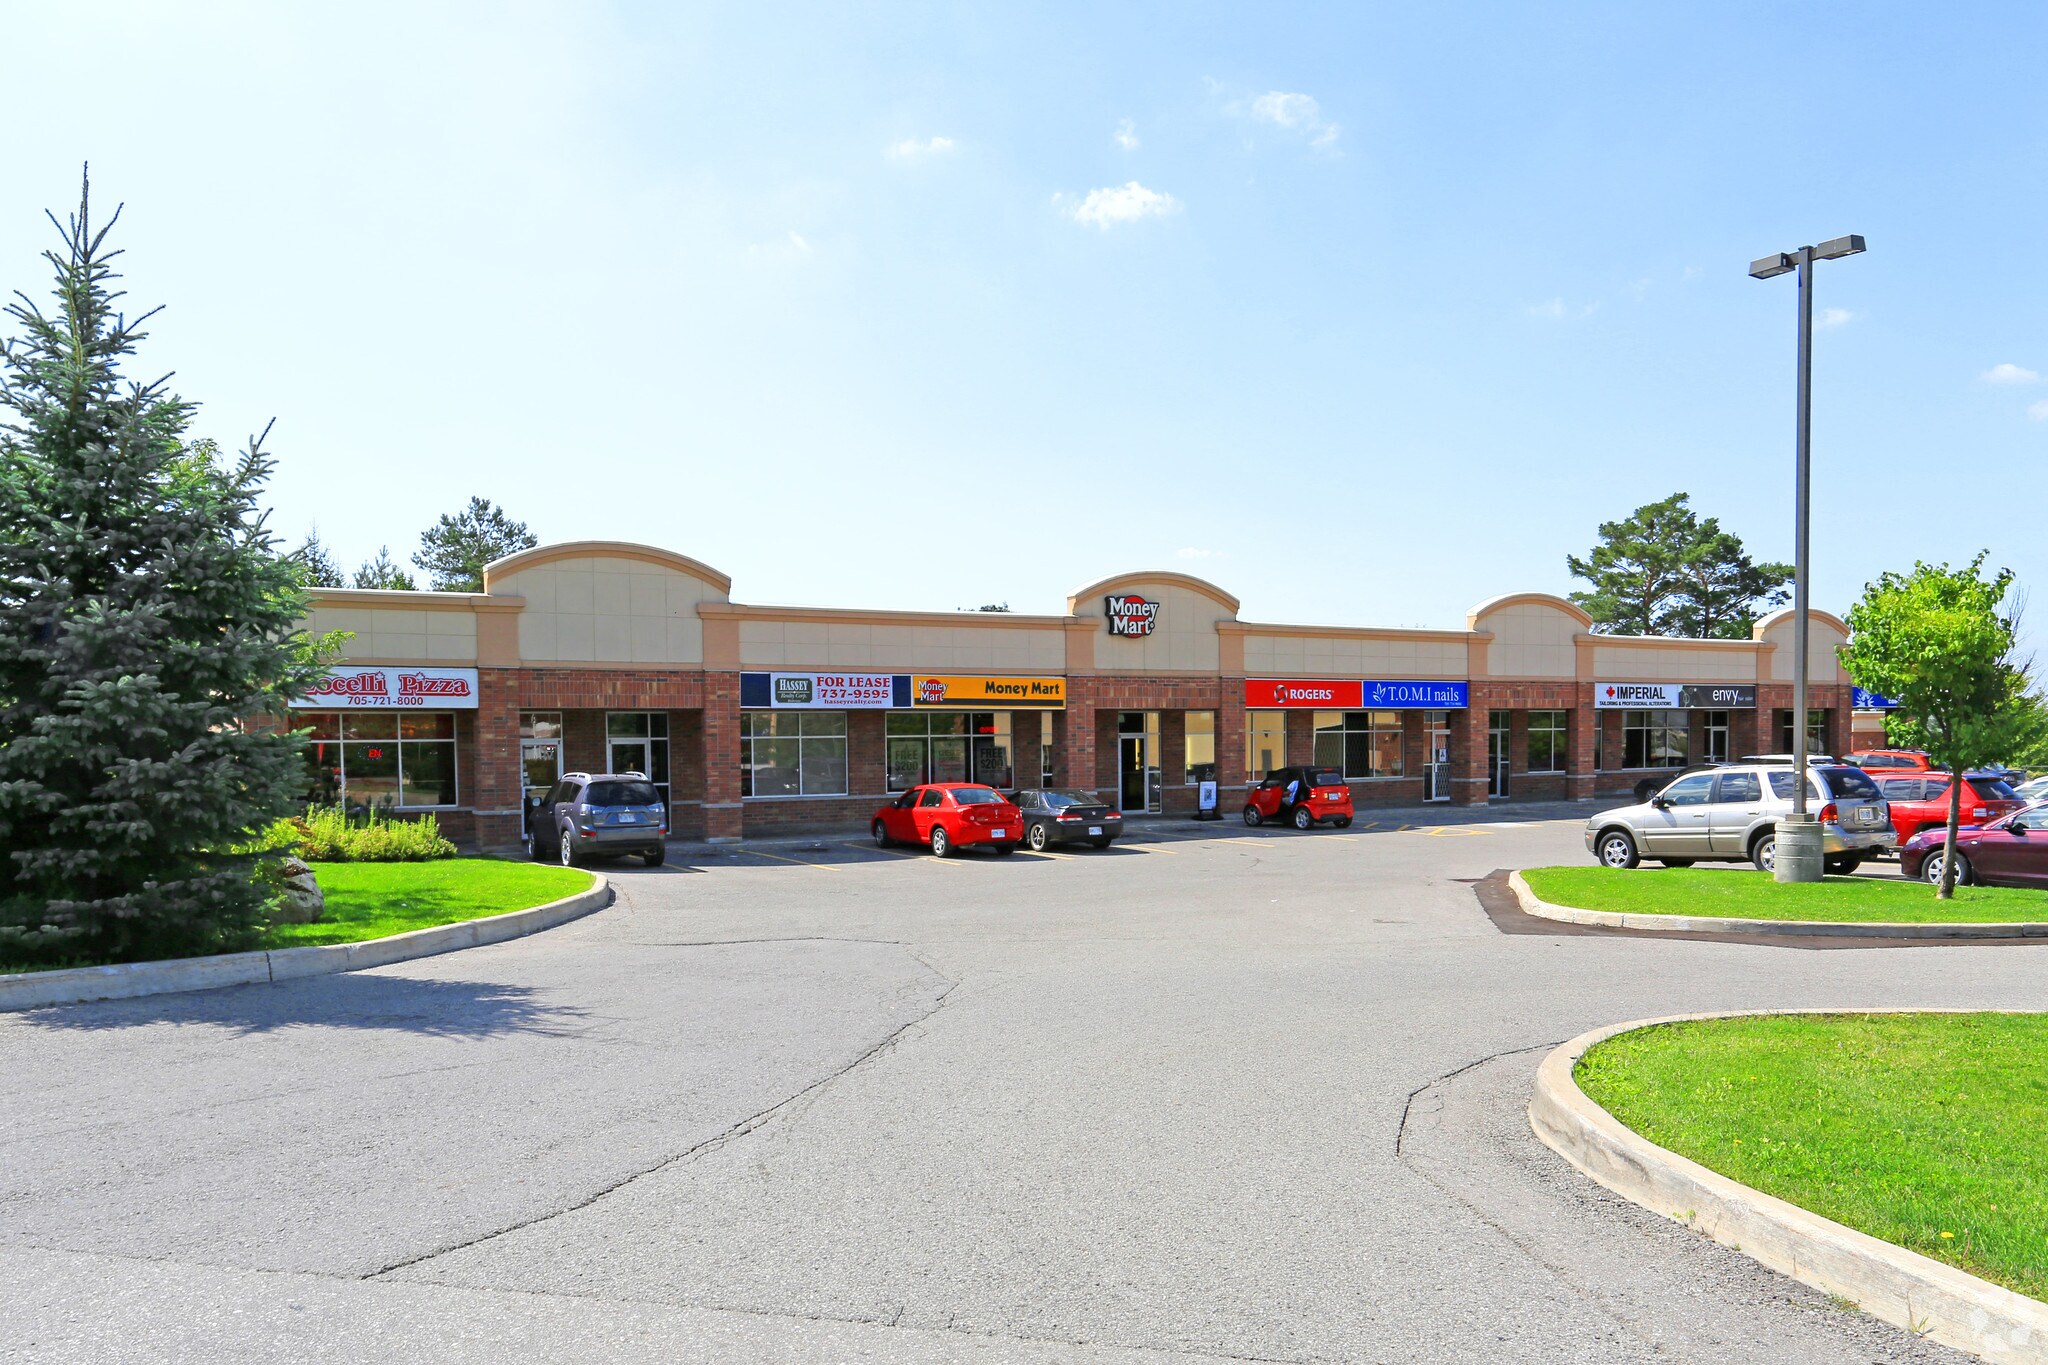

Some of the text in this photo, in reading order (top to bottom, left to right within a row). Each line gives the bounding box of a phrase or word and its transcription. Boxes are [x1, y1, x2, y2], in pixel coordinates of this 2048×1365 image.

[1108, 597, 1159, 622] Money
[1112, 615, 1152, 634] Mart
[303, 671, 471, 696] ocelli Pizza
[780, 679, 808, 691] HASSEY
[816, 676, 891, 688] FOR LEASE
[918, 680, 948, 693] Money
[821, 689, 890, 699] 737-9595
[985, 681, 1060, 697] Money Mart
[1290, 689, 1332, 700] ROGERS
[1434, 687, 1459, 702] nails
[1617, 686, 1666, 699] IMPERIAL
[347, 696, 424, 706] 705-721-8000
[920, 691, 944, 702] Mart
[1712, 689, 1739, 706] envy
[895, 750, 918, 760] FREE
[980, 748, 1003, 759] FREE
